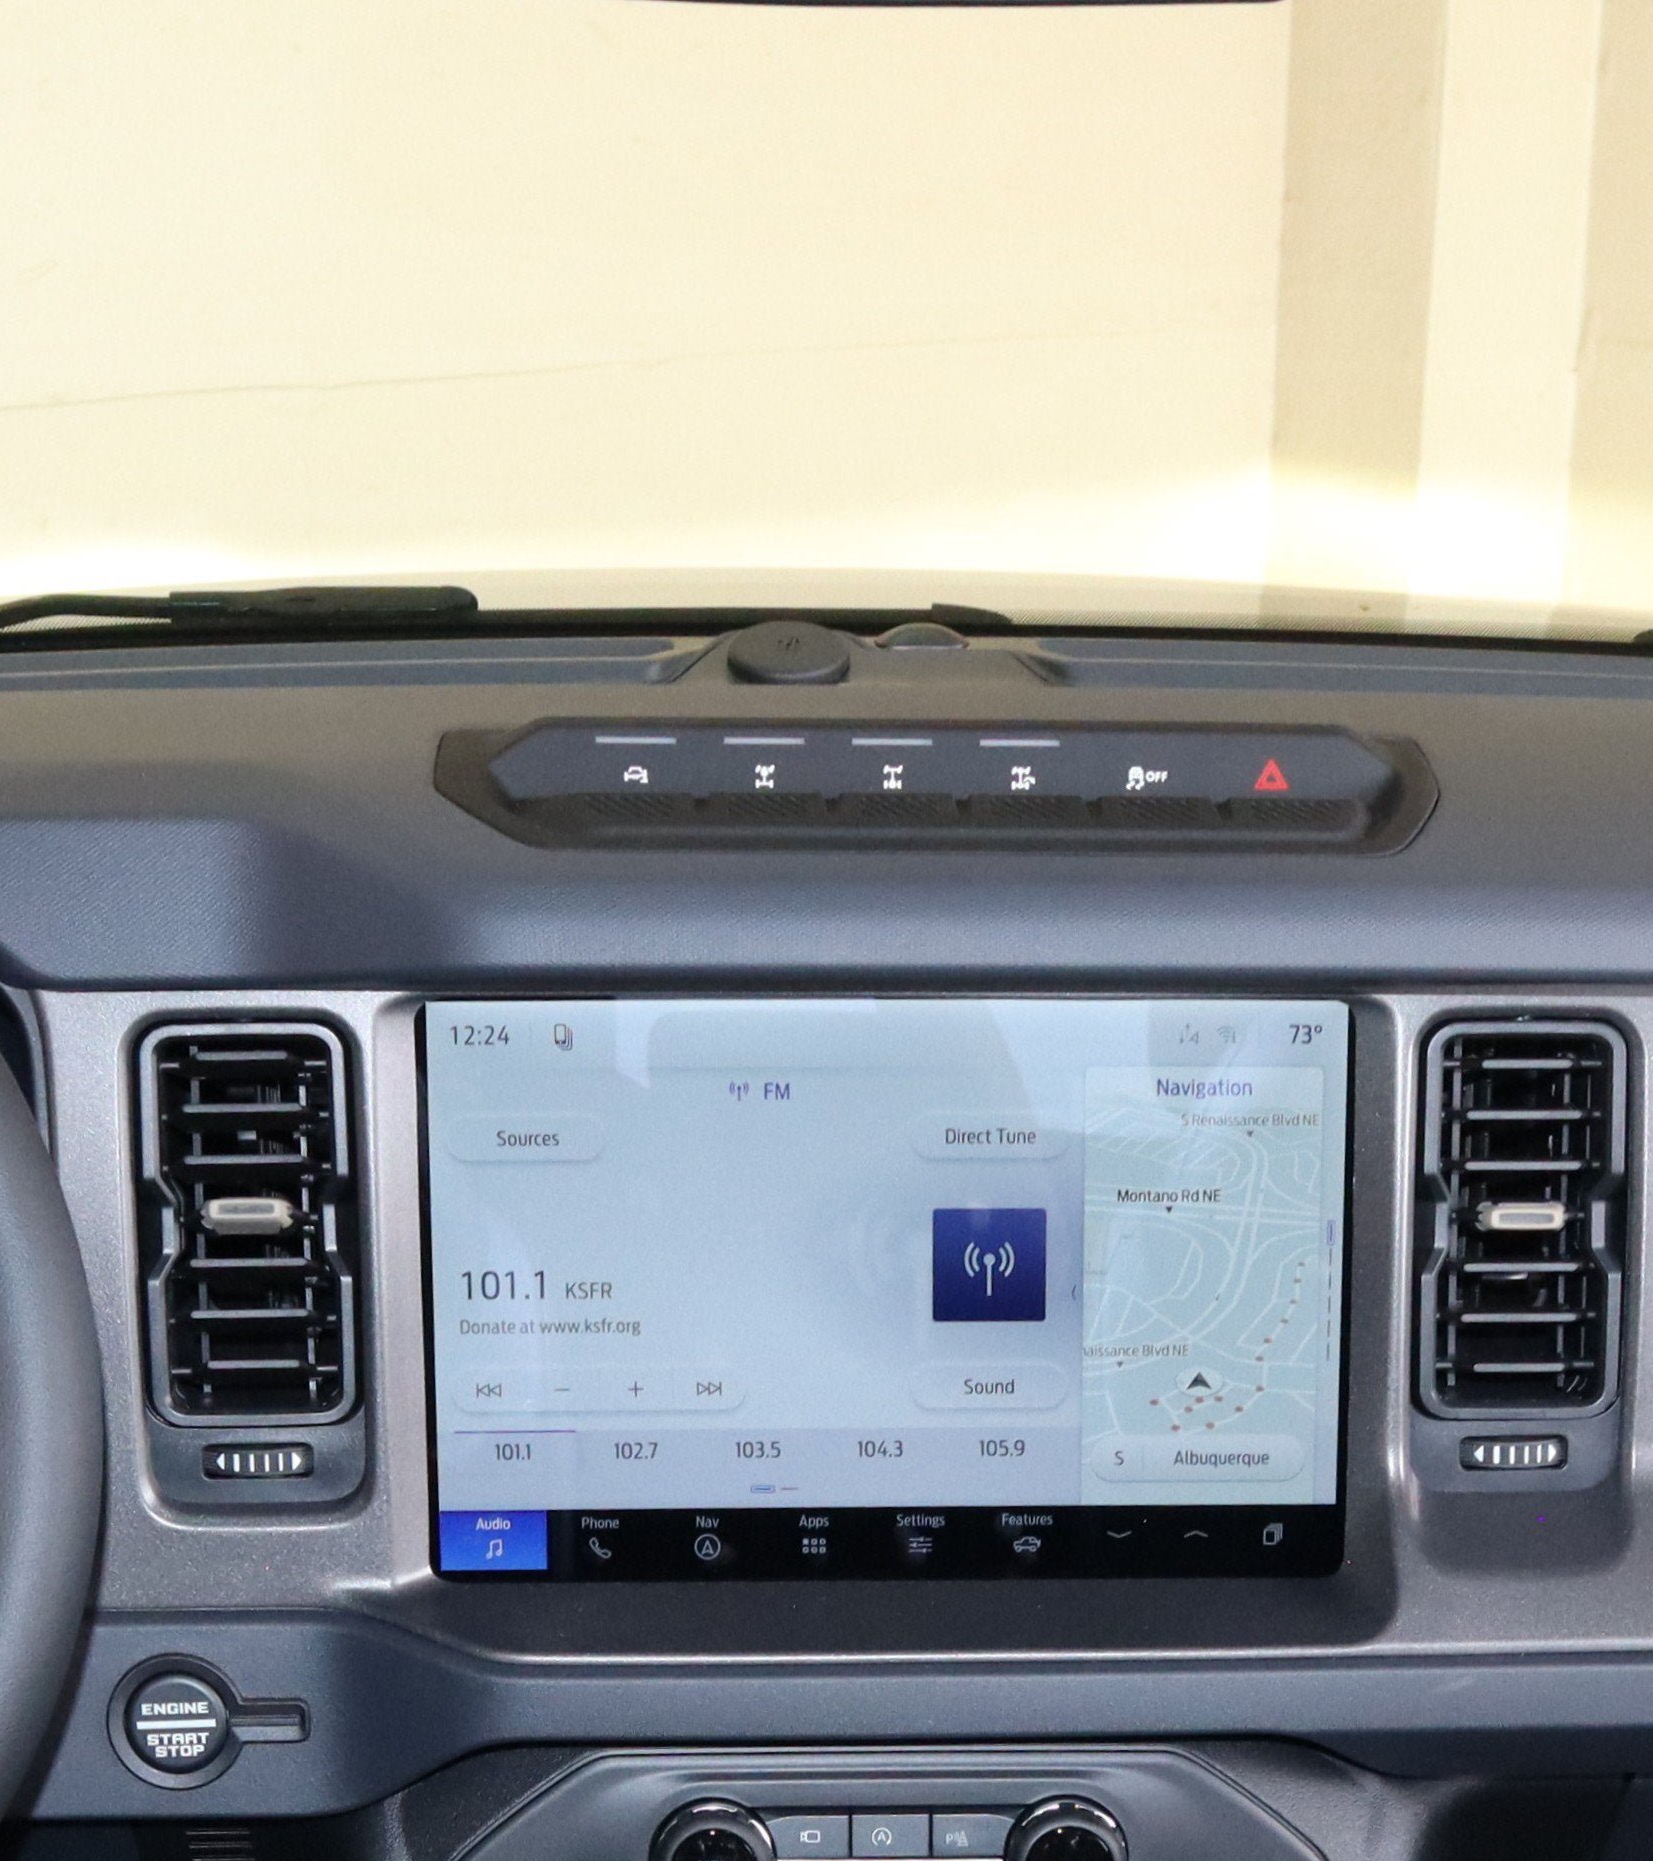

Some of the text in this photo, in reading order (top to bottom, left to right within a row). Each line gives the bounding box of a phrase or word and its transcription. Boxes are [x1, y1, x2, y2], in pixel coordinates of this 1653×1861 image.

[1146, 771, 1168, 783] OFF
[450, 1025, 510, 1046] 12:24
[1289, 1025, 1323, 1045] 73°
[763, 1082, 791, 1100] FM
[1156, 1078, 1253, 1099] Navigation
[1192, 1113, 1269, 1127] Renaissance
[1272, 1113, 1300, 1126] Blvd
[1302, 1114, 1320, 1126] NE
[497, 1130, 560, 1147] Sources
[944, 1128, 1037, 1145] Direct Tune
[1117, 1188, 1222, 1203] Montano Rd NE
[461, 1270, 613, 1300] 101.1 KSFR
[459, 1318, 641, 1336] Donate at www.ksfr.org
[1142, 1345, 1170, 1357] Blvd
[1172, 1345, 1189, 1356] NE
[963, 1378, 1015, 1395] Sound
[495, 1443, 531, 1461] 101.1
[614, 1442, 658, 1460] 102.7
[735, 1441, 781, 1459] 103.5
[857, 1440, 903, 1457] 104.3
[979, 1439, 1025, 1457] 105.9
[1114, 1450, 1124, 1466] S
[1173, 1450, 1269, 1468] Albuquerque
[476, 1517, 511, 1530] Audio
[581, 1516, 619, 1529] Phone
[696, 1515, 719, 1528] Nav
[799, 1514, 830, 1529] Apps
[896, 1513, 946, 1529] Settings
[1001, 1512, 1053, 1527] Features
[141, 1701, 209, 1716] ENGINE
[147, 1732, 210, 1746] START
[155, 1744, 205, 1758] STOP
